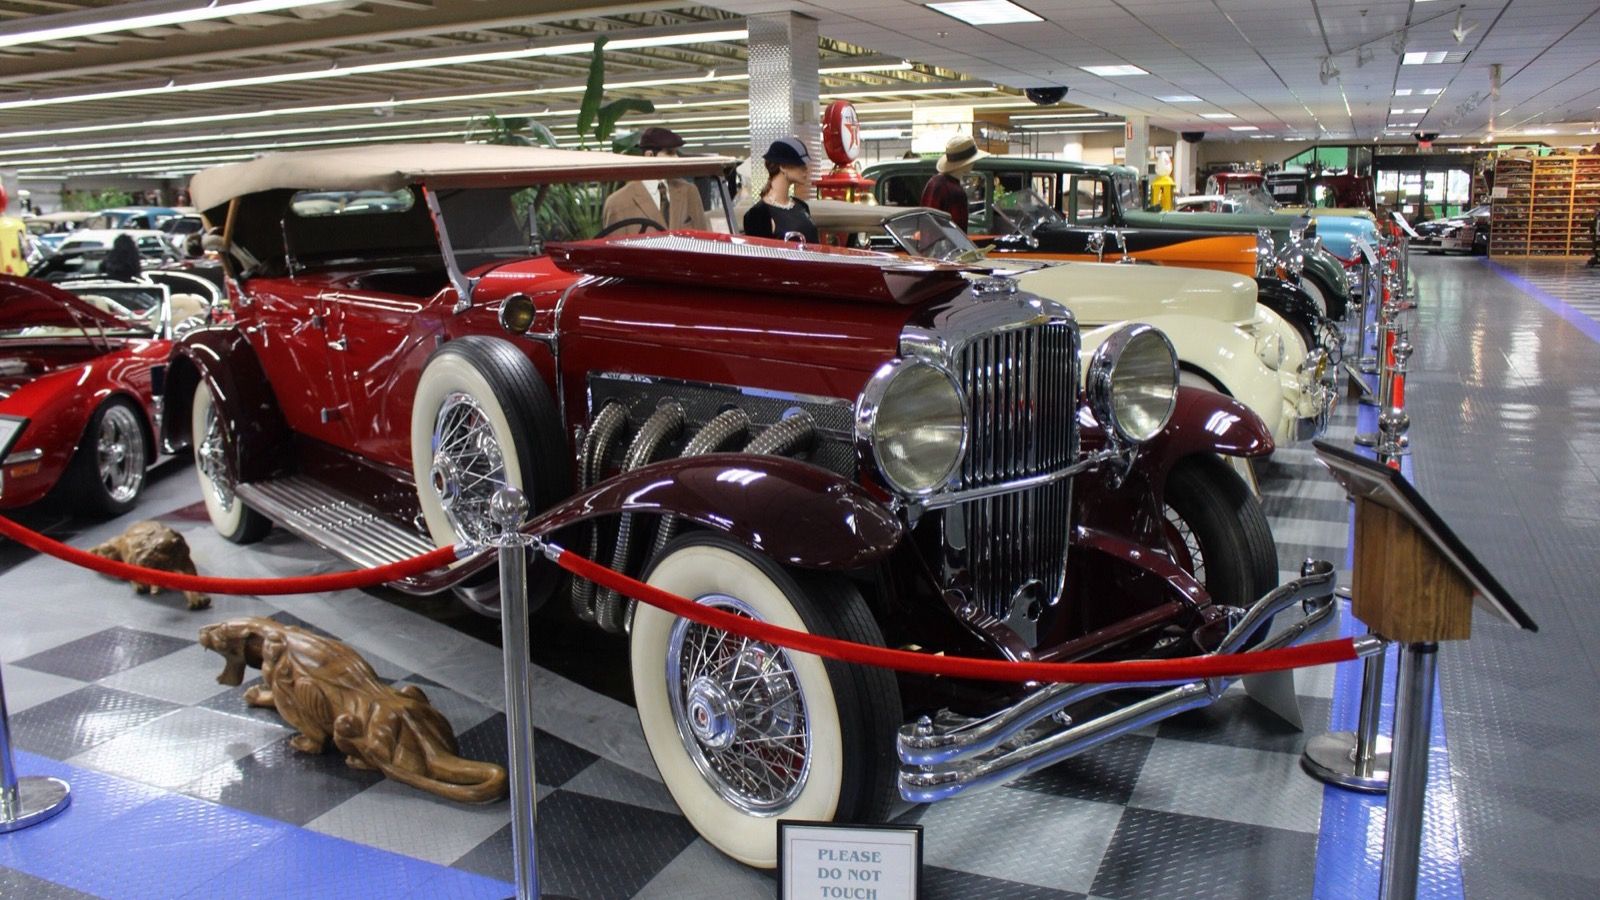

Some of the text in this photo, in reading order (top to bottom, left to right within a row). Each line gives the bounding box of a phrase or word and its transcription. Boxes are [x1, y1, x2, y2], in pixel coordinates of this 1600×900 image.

[818, 848, 881, 863] PLEASE
[818, 867, 882, 882] DO NOT
[821, 886, 877, 900] TOUCH
